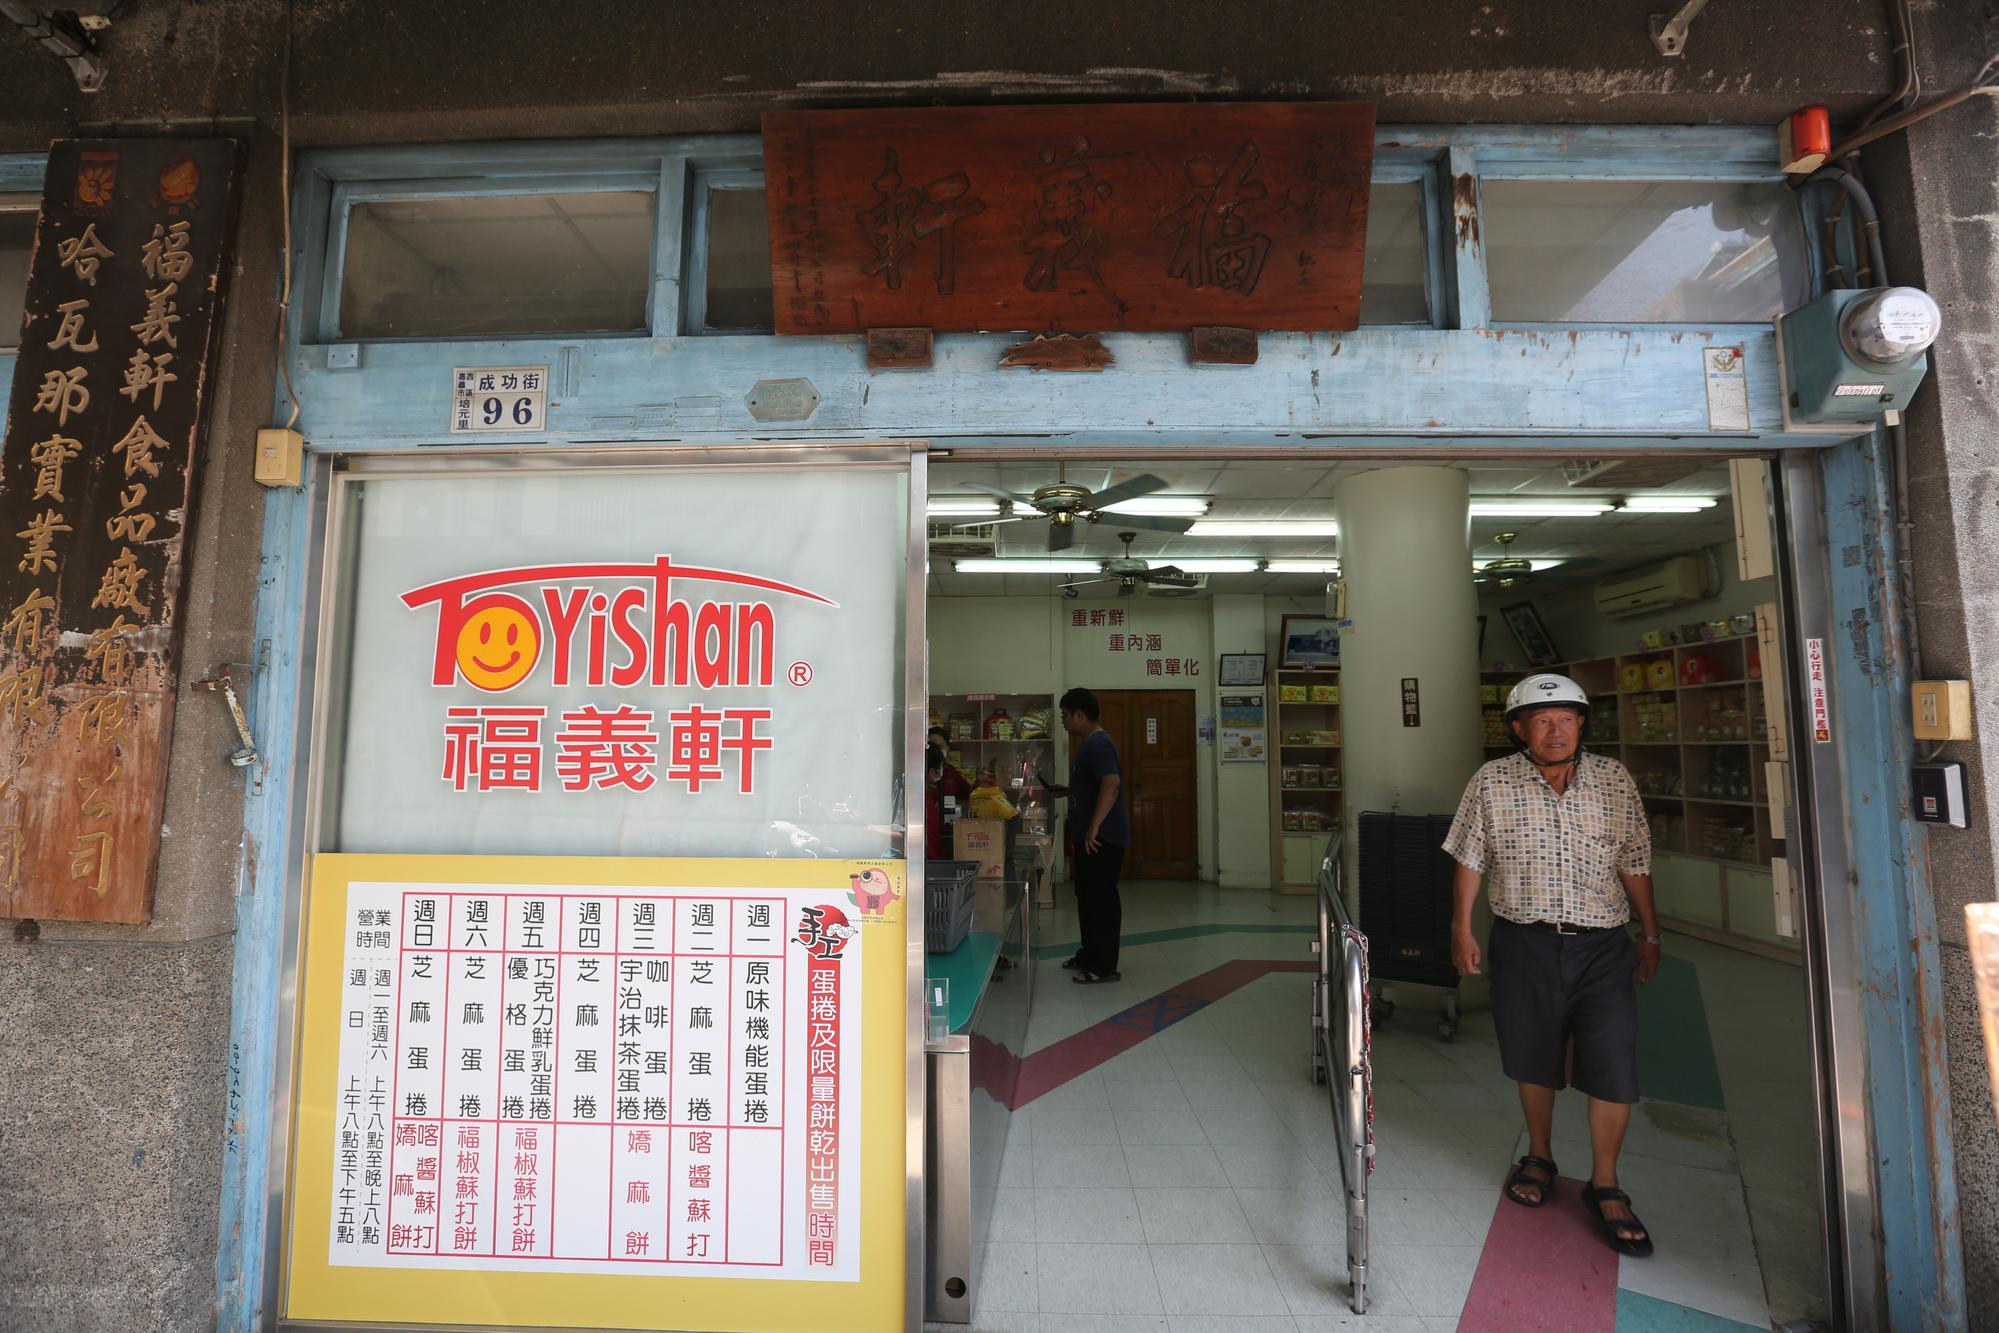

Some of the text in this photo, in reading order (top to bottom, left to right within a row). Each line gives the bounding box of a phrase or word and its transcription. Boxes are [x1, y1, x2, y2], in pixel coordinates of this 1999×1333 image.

[856, 134, 1271, 304] 福義軒
[457, 399, 470, 430] 培元里
[479, 373, 540, 391] 成功街
[483, 397, 532, 424] 96
[69, 220, 194, 896] 福義軒食品廠有限公司
[1072, 609, 1124, 627] 重新鮮
[1108, 634, 1162, 652] 重內涵
[1146, 658, 1200, 676] 簡單化
[1809, 640, 1822, 681] 小心行走
[441, 703, 775, 795] 福義軒
[356, 931, 391, 949] 時間
[357, 909, 392, 927] 營業
[414, 899, 435, 946] 週日
[465, 900, 488, 947] 週六
[521, 901, 545, 948] 週五
[579, 902, 601, 948] 週四
[633, 903, 655, 950] 週三
[691, 904, 714, 951] 週二
[747, 904, 770, 942] 週一
[405, 955, 433, 1116] 芝麻蛋捲
[459, 956, 486, 1118] 芝麻蛋捲
[502, 957, 528, 1119] 優格蛋捲
[530, 958, 555, 1120] 巧克力鮮乳蛋捲
[573, 958, 600, 1119] 芝麻蛋捲
[616, 960, 643, 1121] 宇治抹茶蛋捲
[644, 960, 669, 1121] 咖啡蛋捲
[687, 960, 714, 1122] 芝麻蛋捲
[744, 961, 770, 1123] 原味機能蛋捲
[791, 907, 843, 1267] 手工 蛋捲及限量餅乾出售時間
[337, 1075, 361, 1244] 上午八點至下午五點
[362, 969, 391, 1245] 週一至週六 上午八點至晚上八點
[391, 1123, 416, 1248] 嬌麻餅
[413, 1124, 439, 1249] 喀醬蘇打
[453, 1126, 480, 1251] 福椒蘇打餅
[512, 1127, 538, 1252] 福椒蘇打餅
[625, 1130, 652, 1256] 嬌麻餅
[686, 1131, 712, 1257] 喀醬蘇打
